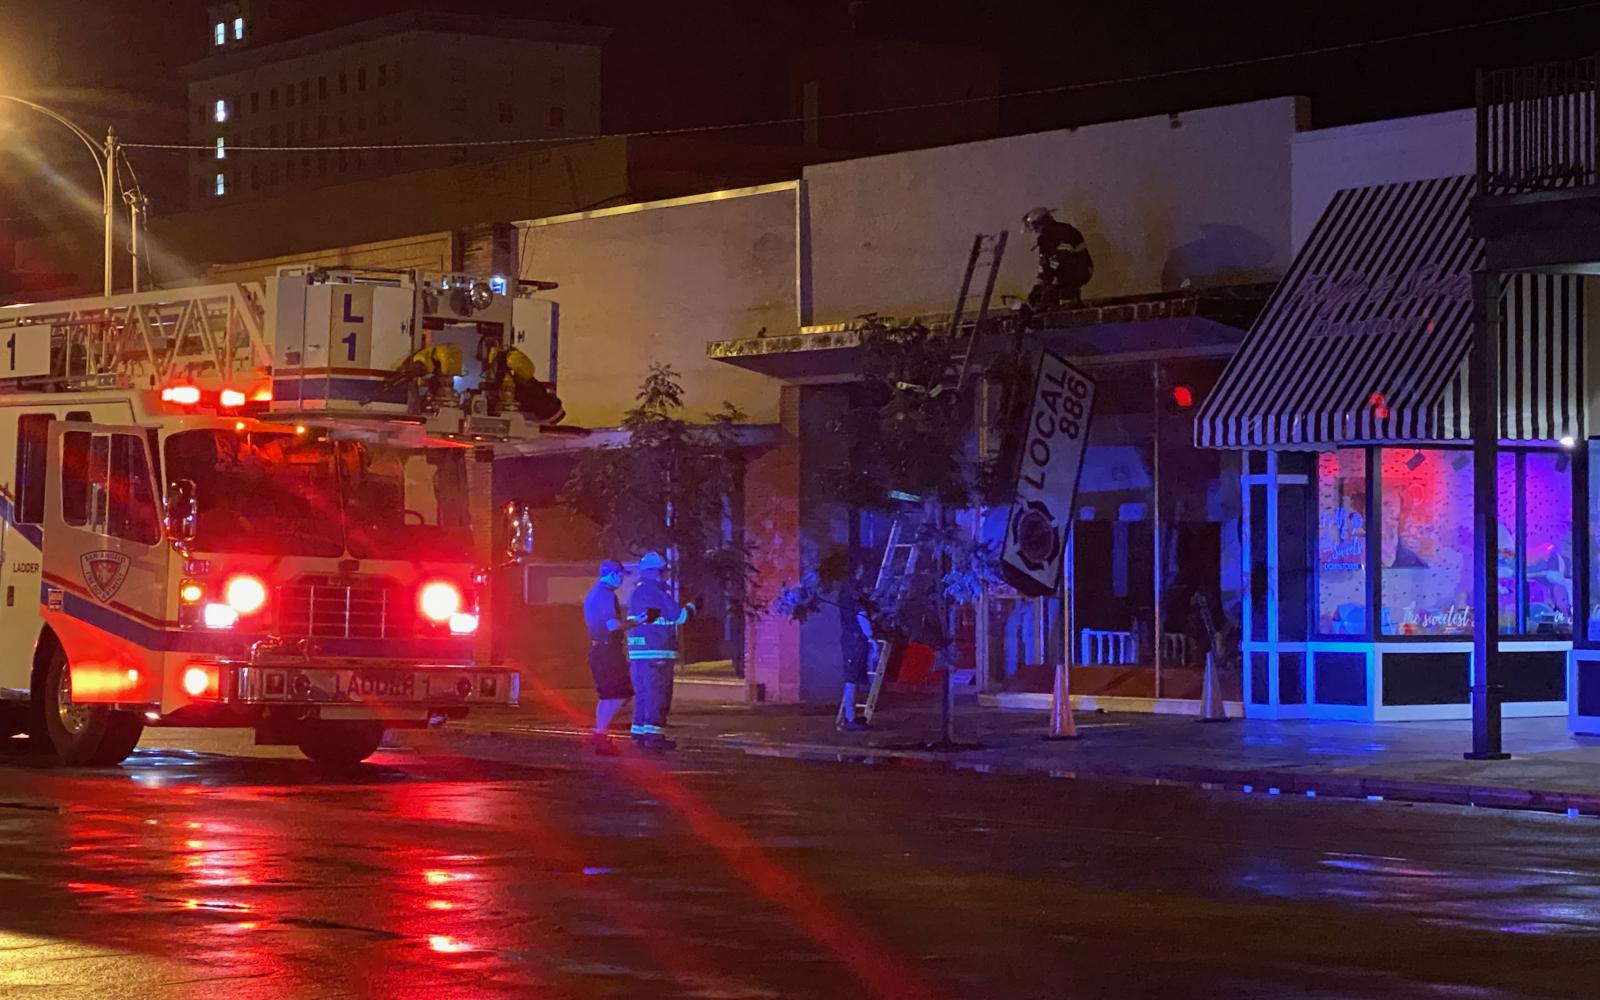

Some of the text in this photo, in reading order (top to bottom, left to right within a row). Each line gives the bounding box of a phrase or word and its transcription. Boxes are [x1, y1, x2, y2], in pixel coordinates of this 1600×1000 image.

[344, 294, 364, 323] L
[7, 333, 15, 370] 1
[342, 333, 356, 361] 1
[1059, 375, 1088, 440] 886
[1025, 370, 1067, 490] LOCAL
[13, 563, 39, 573] LADDER
[1422, 605, 1470, 627] sweetest
[336, 674, 413, 698] LADDER
